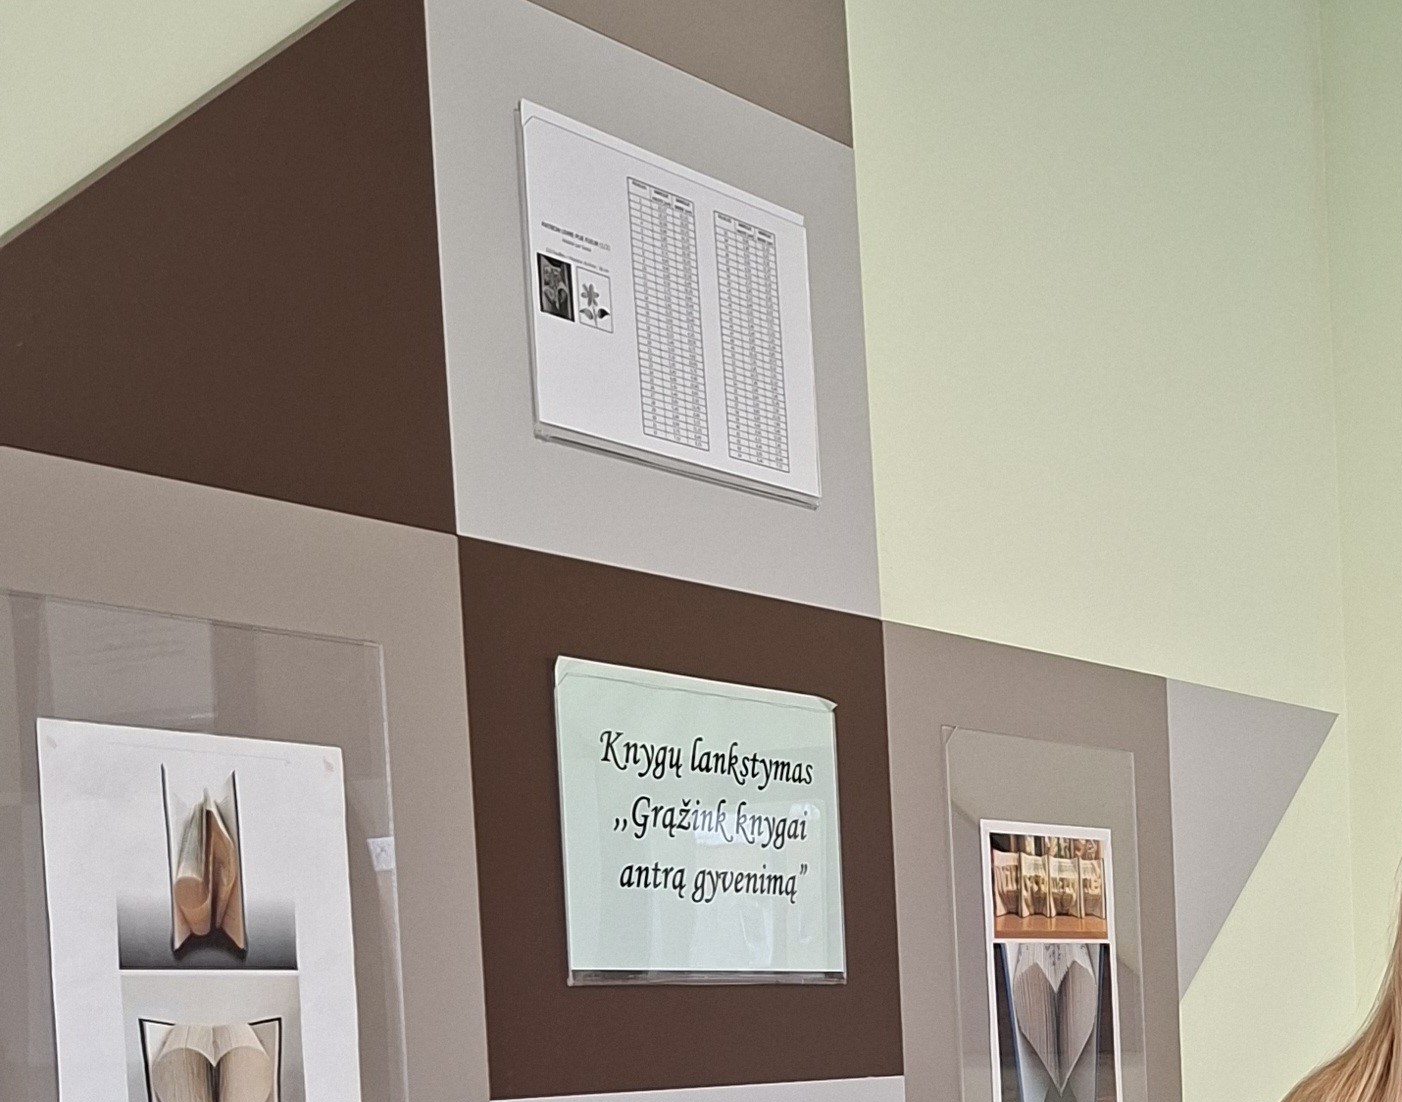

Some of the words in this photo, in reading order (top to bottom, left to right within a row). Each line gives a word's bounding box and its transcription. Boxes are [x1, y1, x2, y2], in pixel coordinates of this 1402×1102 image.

[600, 730, 682, 779] Knygų
[690, 737, 813, 790] lankstymas
[736, 801, 807, 850] knygai
[619, 862, 686, 898] antrą
